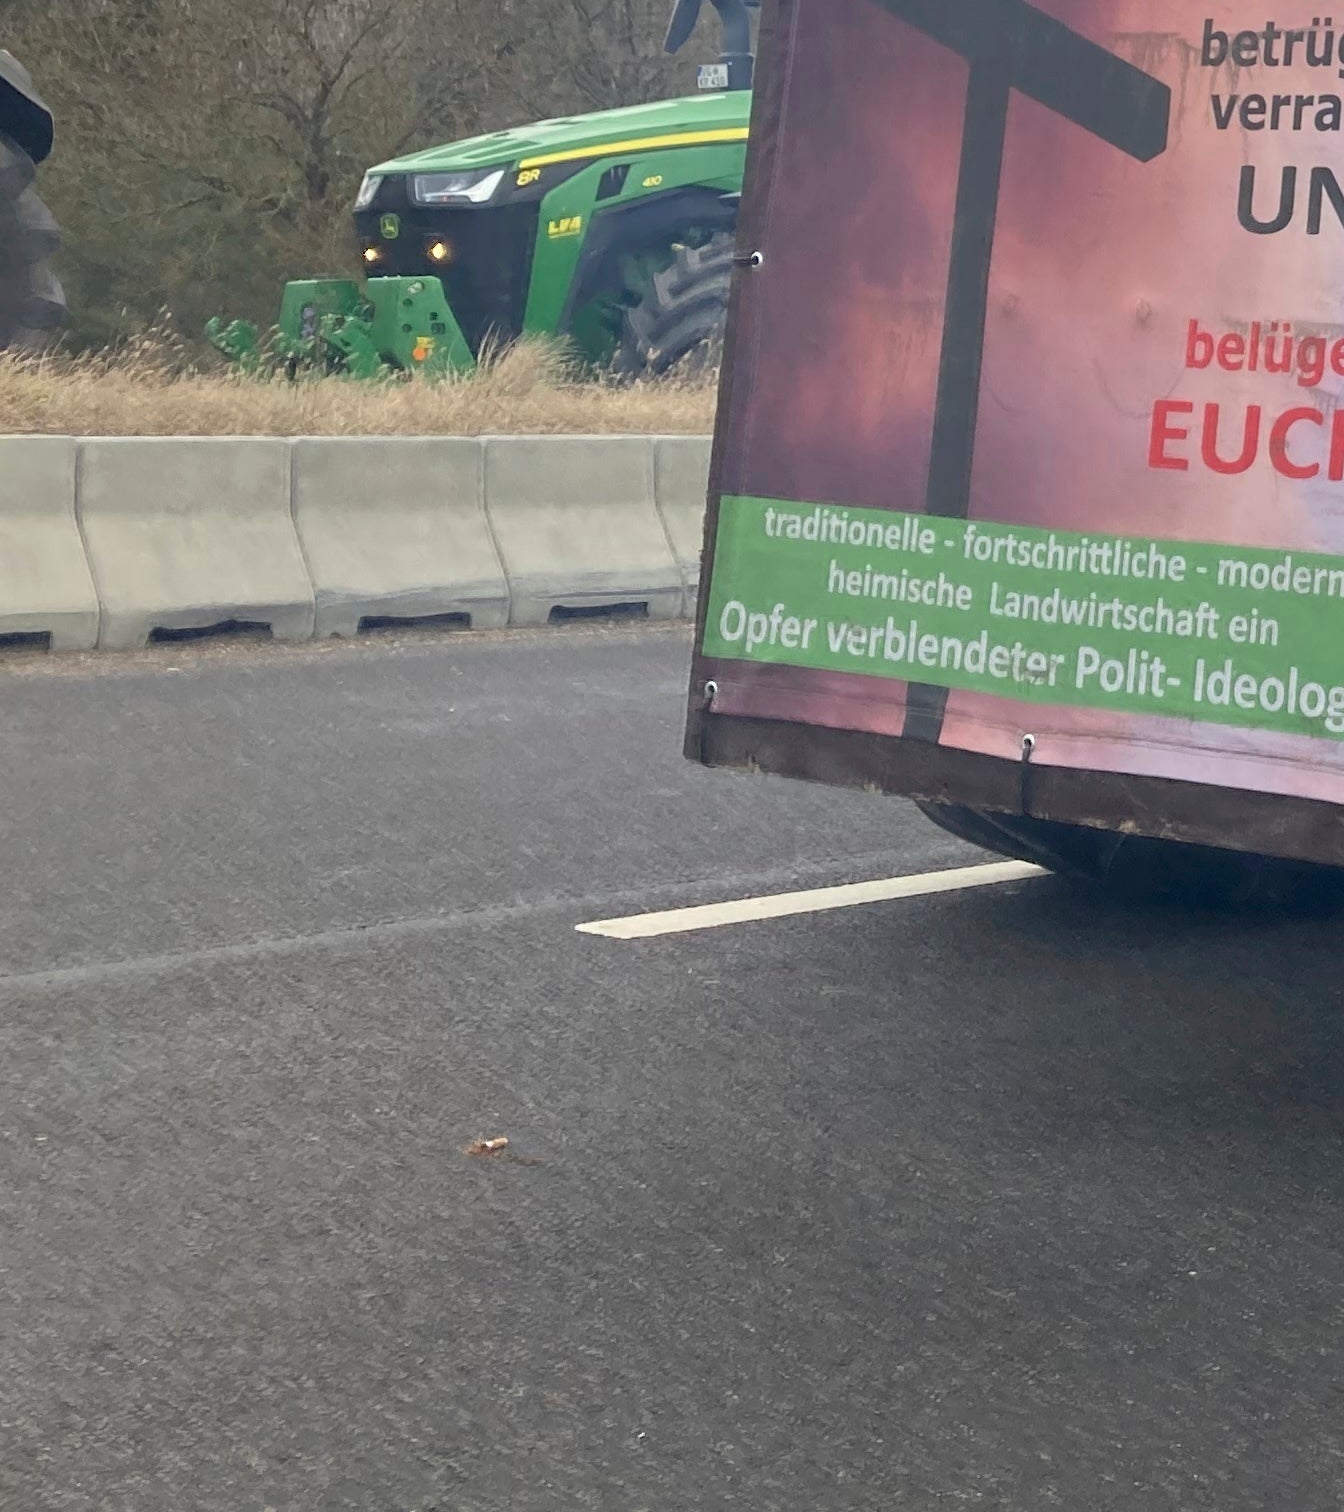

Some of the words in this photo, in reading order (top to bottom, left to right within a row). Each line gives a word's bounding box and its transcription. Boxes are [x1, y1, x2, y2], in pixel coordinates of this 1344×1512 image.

[516, 169, 541, 186] 8R
[764, 507, 936, 554] traditionelle
[963, 525, 1187, 582] fortschrittliche
[828, 561, 973, 612] heimische
[989, 583, 1219, 640] Landwirtschaft
[1228, 608, 1279, 646] ein
[719, 601, 816, 652] Opfer
[826, 617, 1065, 687] verblendeter
